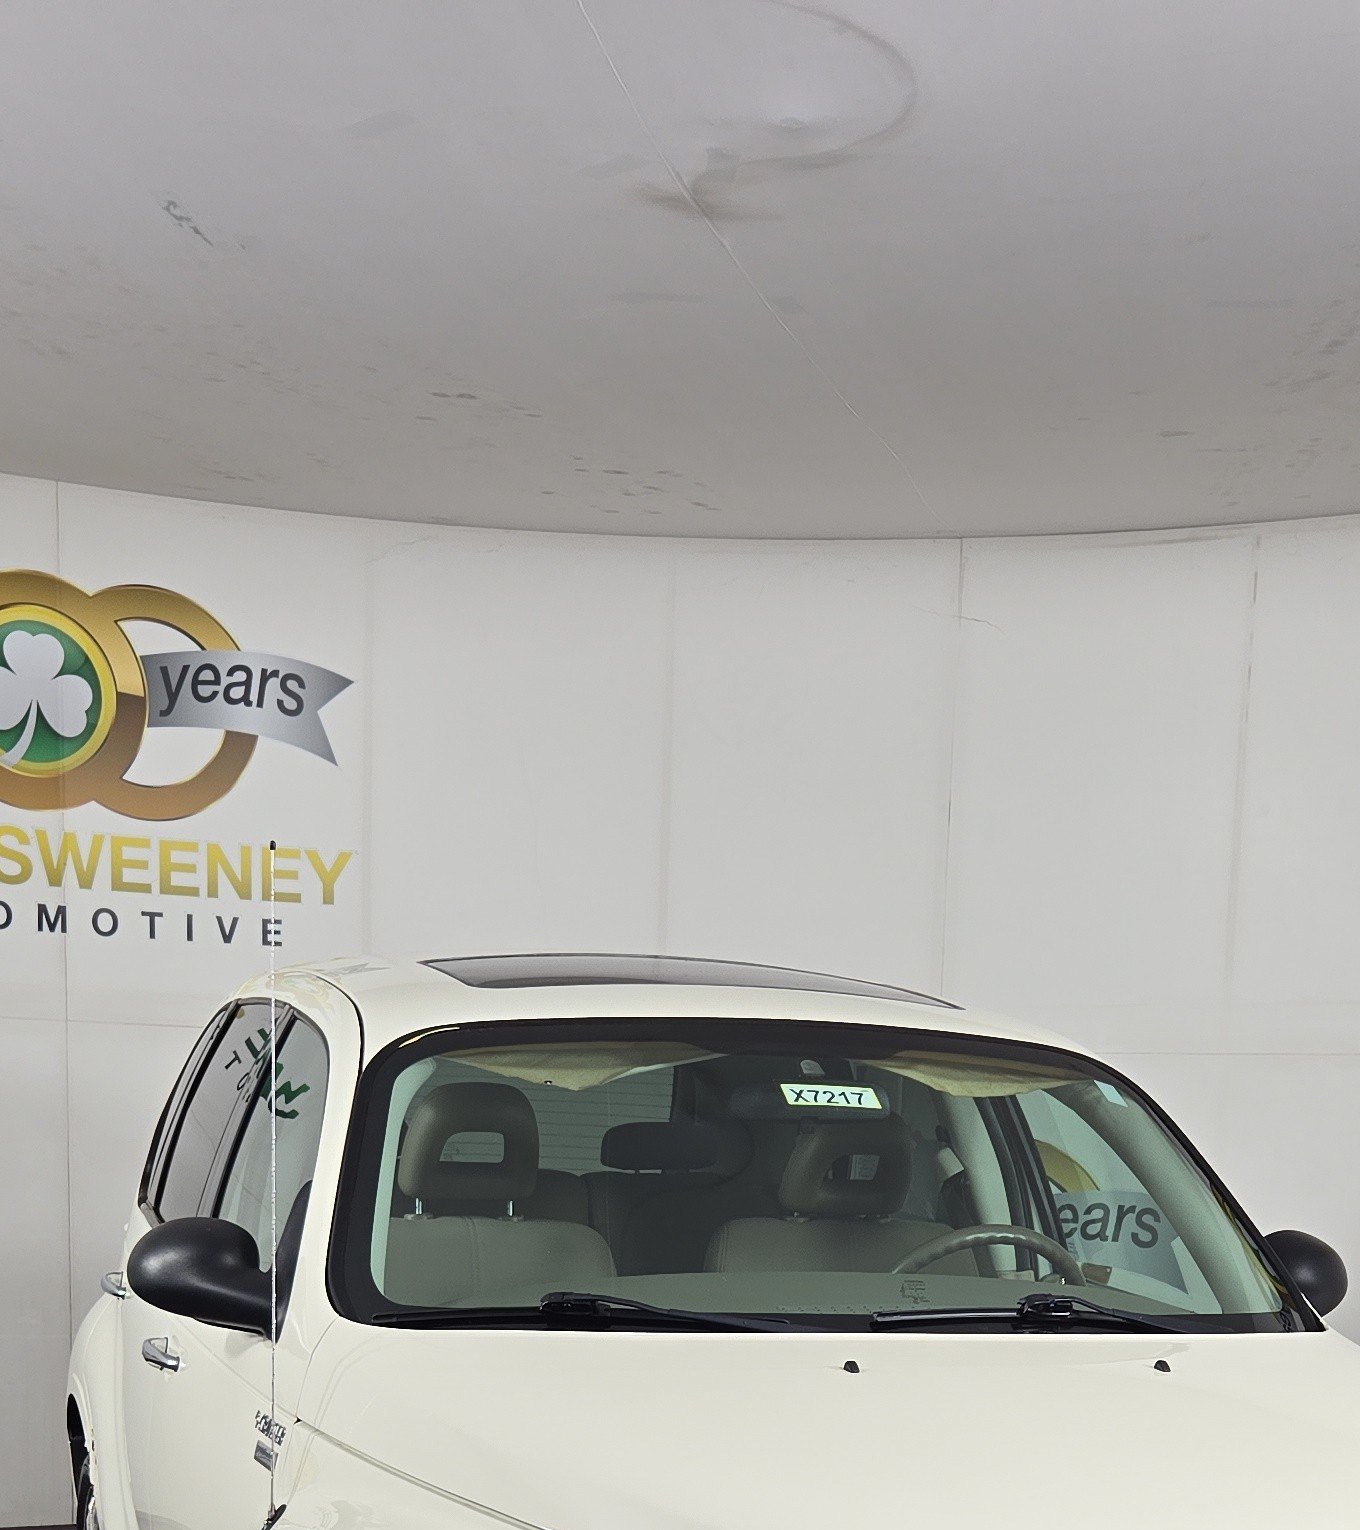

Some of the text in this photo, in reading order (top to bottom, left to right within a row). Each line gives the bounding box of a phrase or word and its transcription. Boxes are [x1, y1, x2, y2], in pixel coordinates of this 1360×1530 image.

[158, 662, 308, 717] years
[789, 1088, 864, 1106] X7217
[1058, 1202, 1161, 1249] ears
